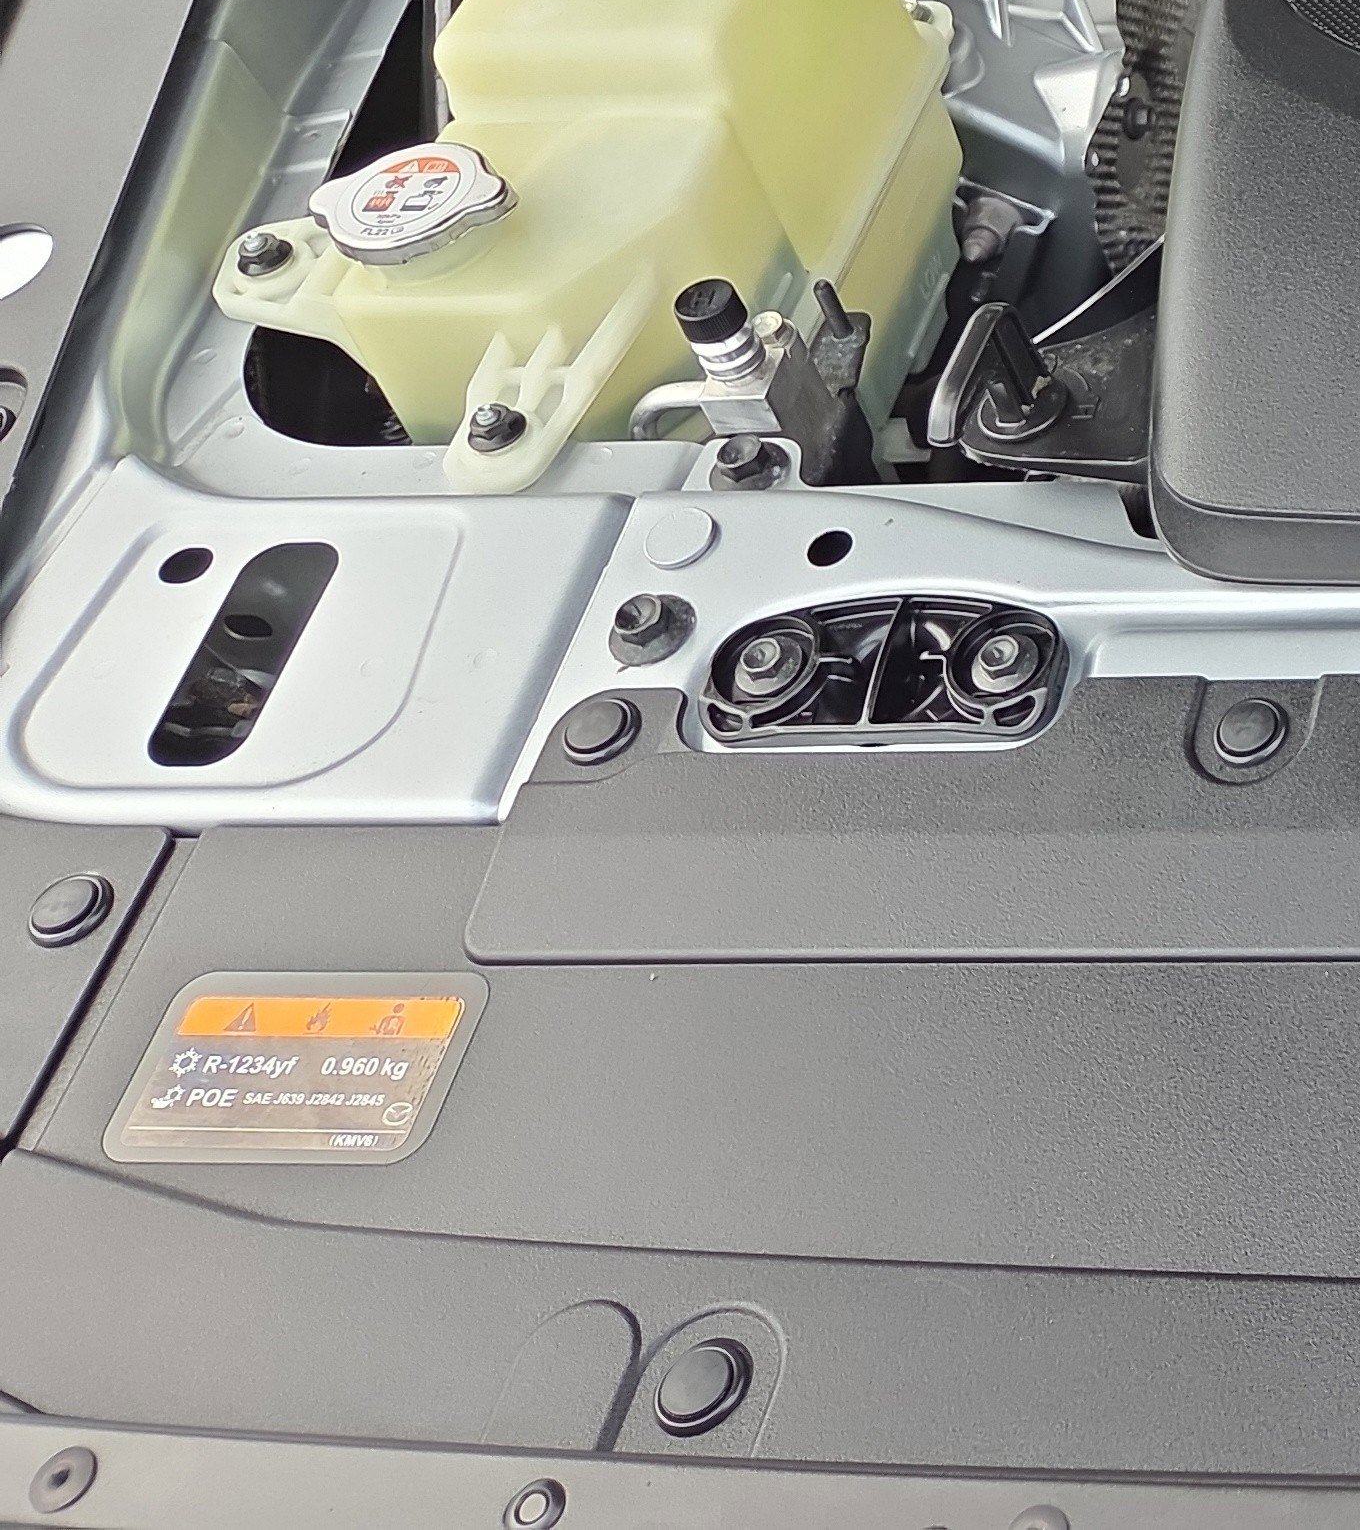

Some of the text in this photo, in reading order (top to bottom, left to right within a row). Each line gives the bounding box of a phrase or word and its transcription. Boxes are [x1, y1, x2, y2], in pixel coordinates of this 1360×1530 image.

[202, 1055, 410, 1081] R-1234yf 0.960 kg
[185, 1088, 386, 1107] POE SAE J639 J2842 J2845
